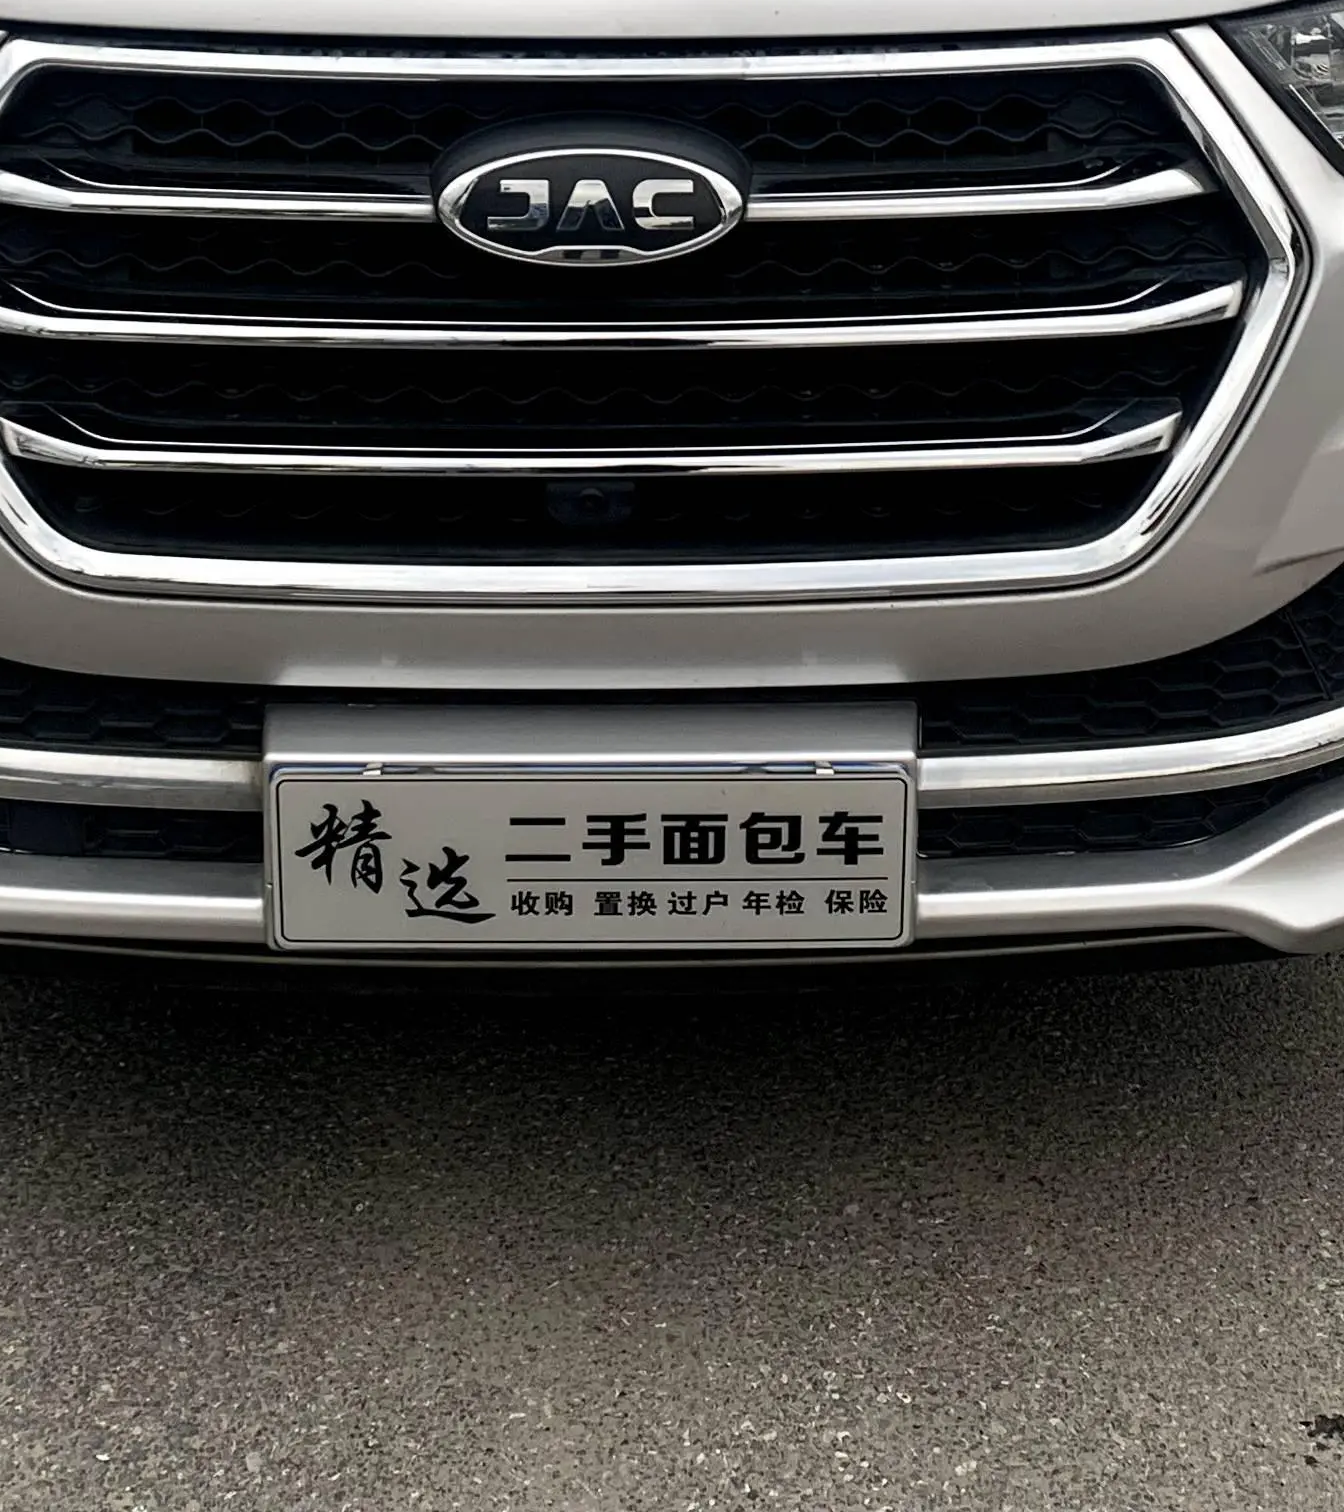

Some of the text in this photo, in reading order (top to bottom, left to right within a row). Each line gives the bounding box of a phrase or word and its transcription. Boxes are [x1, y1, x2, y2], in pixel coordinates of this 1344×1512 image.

[487, 179, 695, 231] JAC
[294, 799, 497, 925] 精选
[504, 810, 885, 866] 二手面包车
[510, 888, 889, 917] 收购 置换 过户 年检 保险
